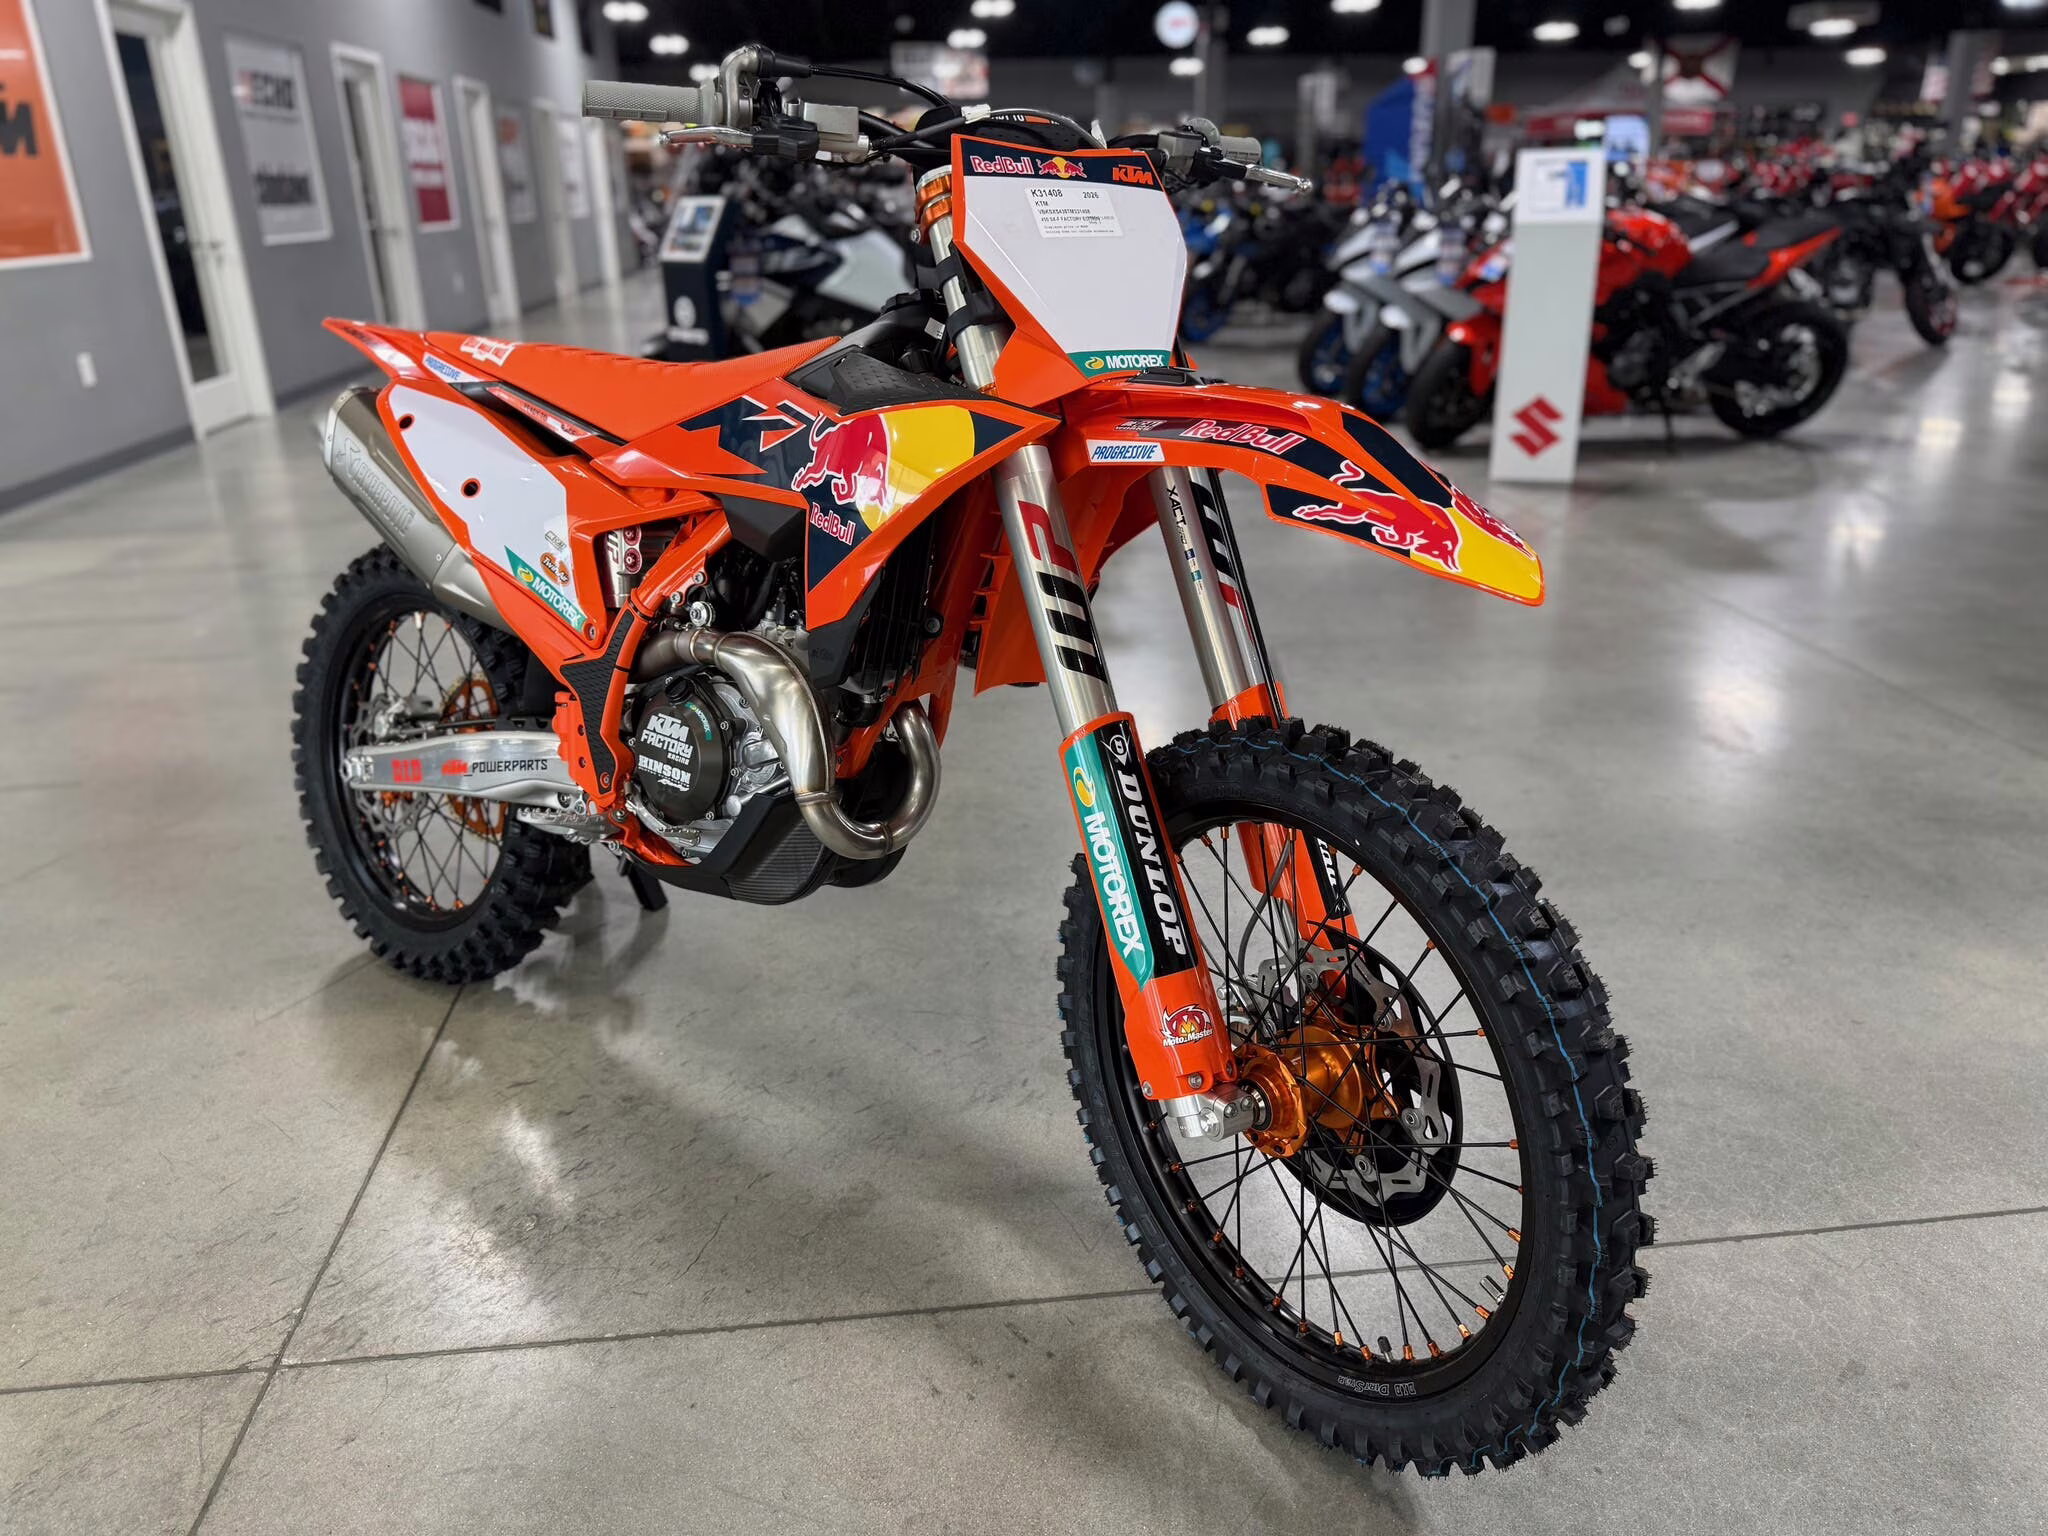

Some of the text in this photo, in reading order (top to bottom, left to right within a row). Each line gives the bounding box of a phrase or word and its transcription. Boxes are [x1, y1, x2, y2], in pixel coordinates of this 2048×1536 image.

[1112, 164, 1154, 185] KTM
[1031, 189, 1100, 199] K31408 2026
[425, 355, 462, 382] PROGRESSIVE
[1105, 354, 1164, 369] MOTOREX
[1091, 444, 1159, 460] PROGRESSIVE
[1167, 485, 1187, 527] XACT
[531, 576, 587, 633] MOTOREX
[647, 713, 690, 743] KTM
[640, 729, 693, 759] FACTORY
[638, 755, 691, 784] HINSON
[1117, 770, 1187, 956] DUNLOP
[1084, 812, 1147, 958] MOTOREX
